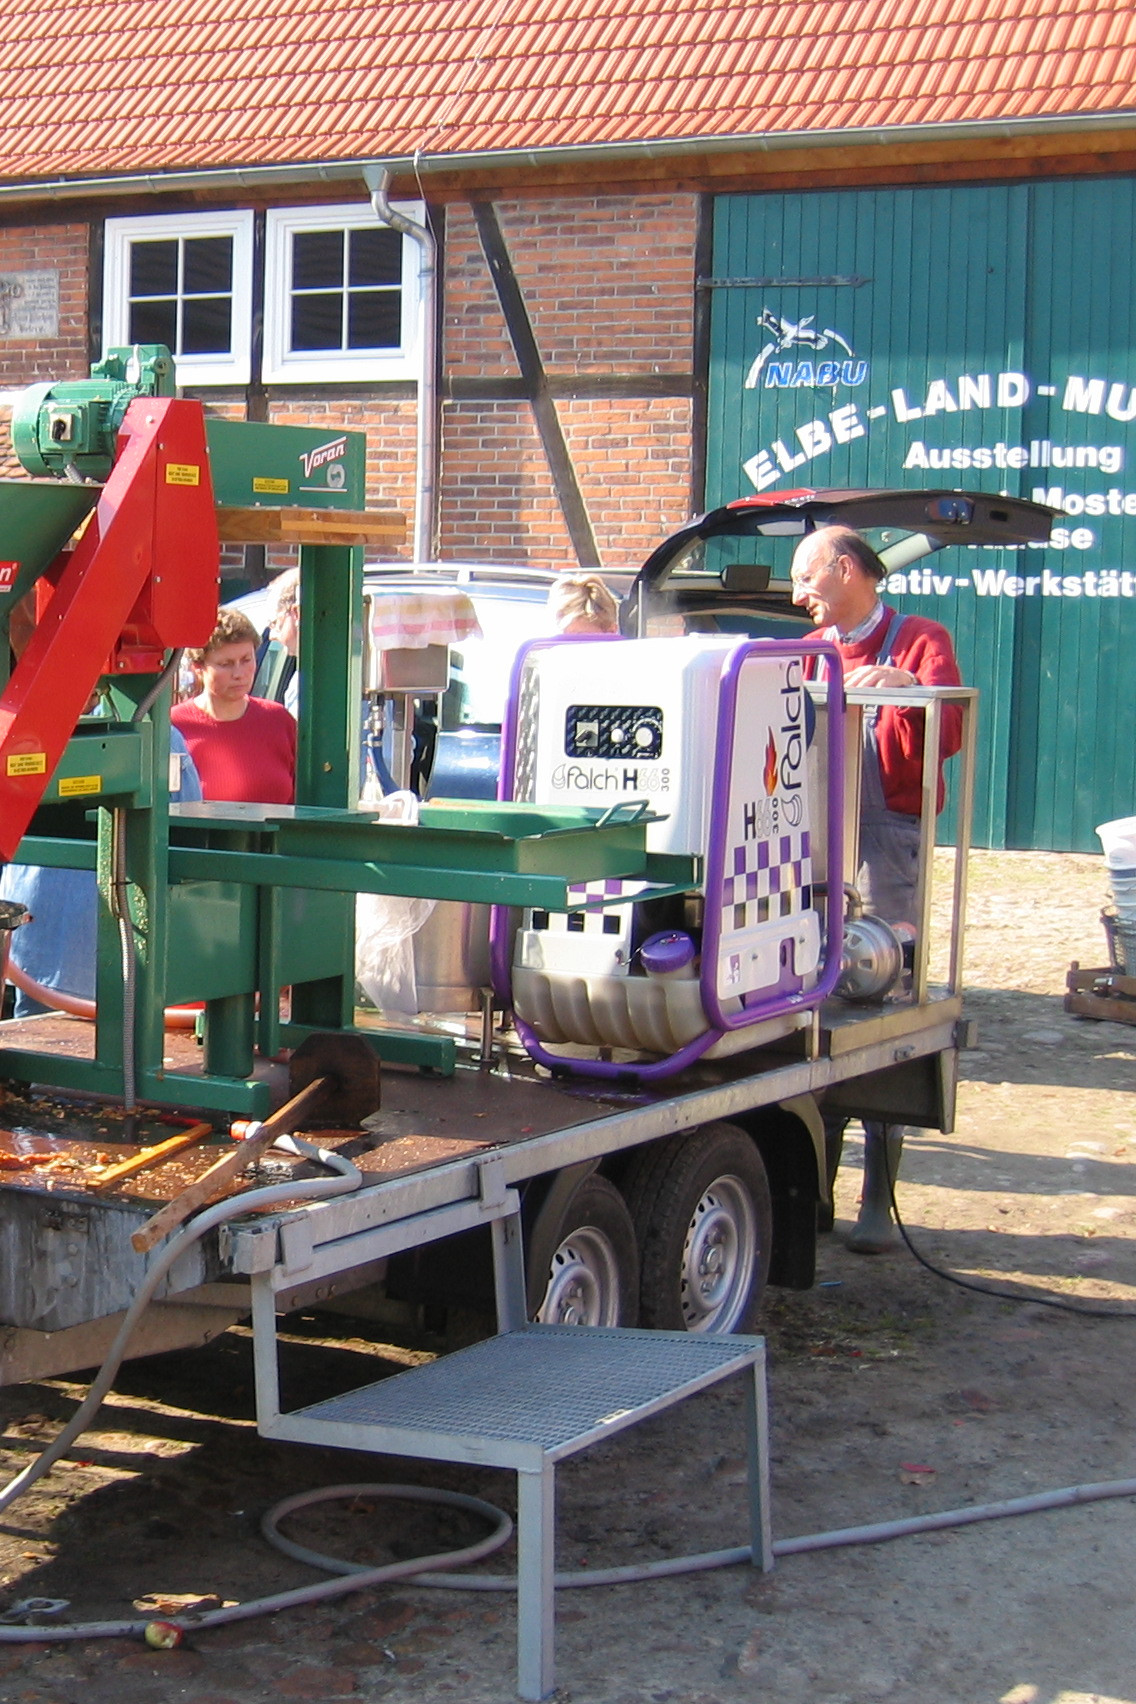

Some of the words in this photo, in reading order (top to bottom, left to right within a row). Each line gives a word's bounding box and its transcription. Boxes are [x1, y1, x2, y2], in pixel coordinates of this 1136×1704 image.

[764, 361, 868, 389] NABU
[298, 436, 348, 478] Voran
[904, 440, 1123, 474] Ausstellung
[780, 660, 802, 791] falch
[567, 766, 618, 790] falch
